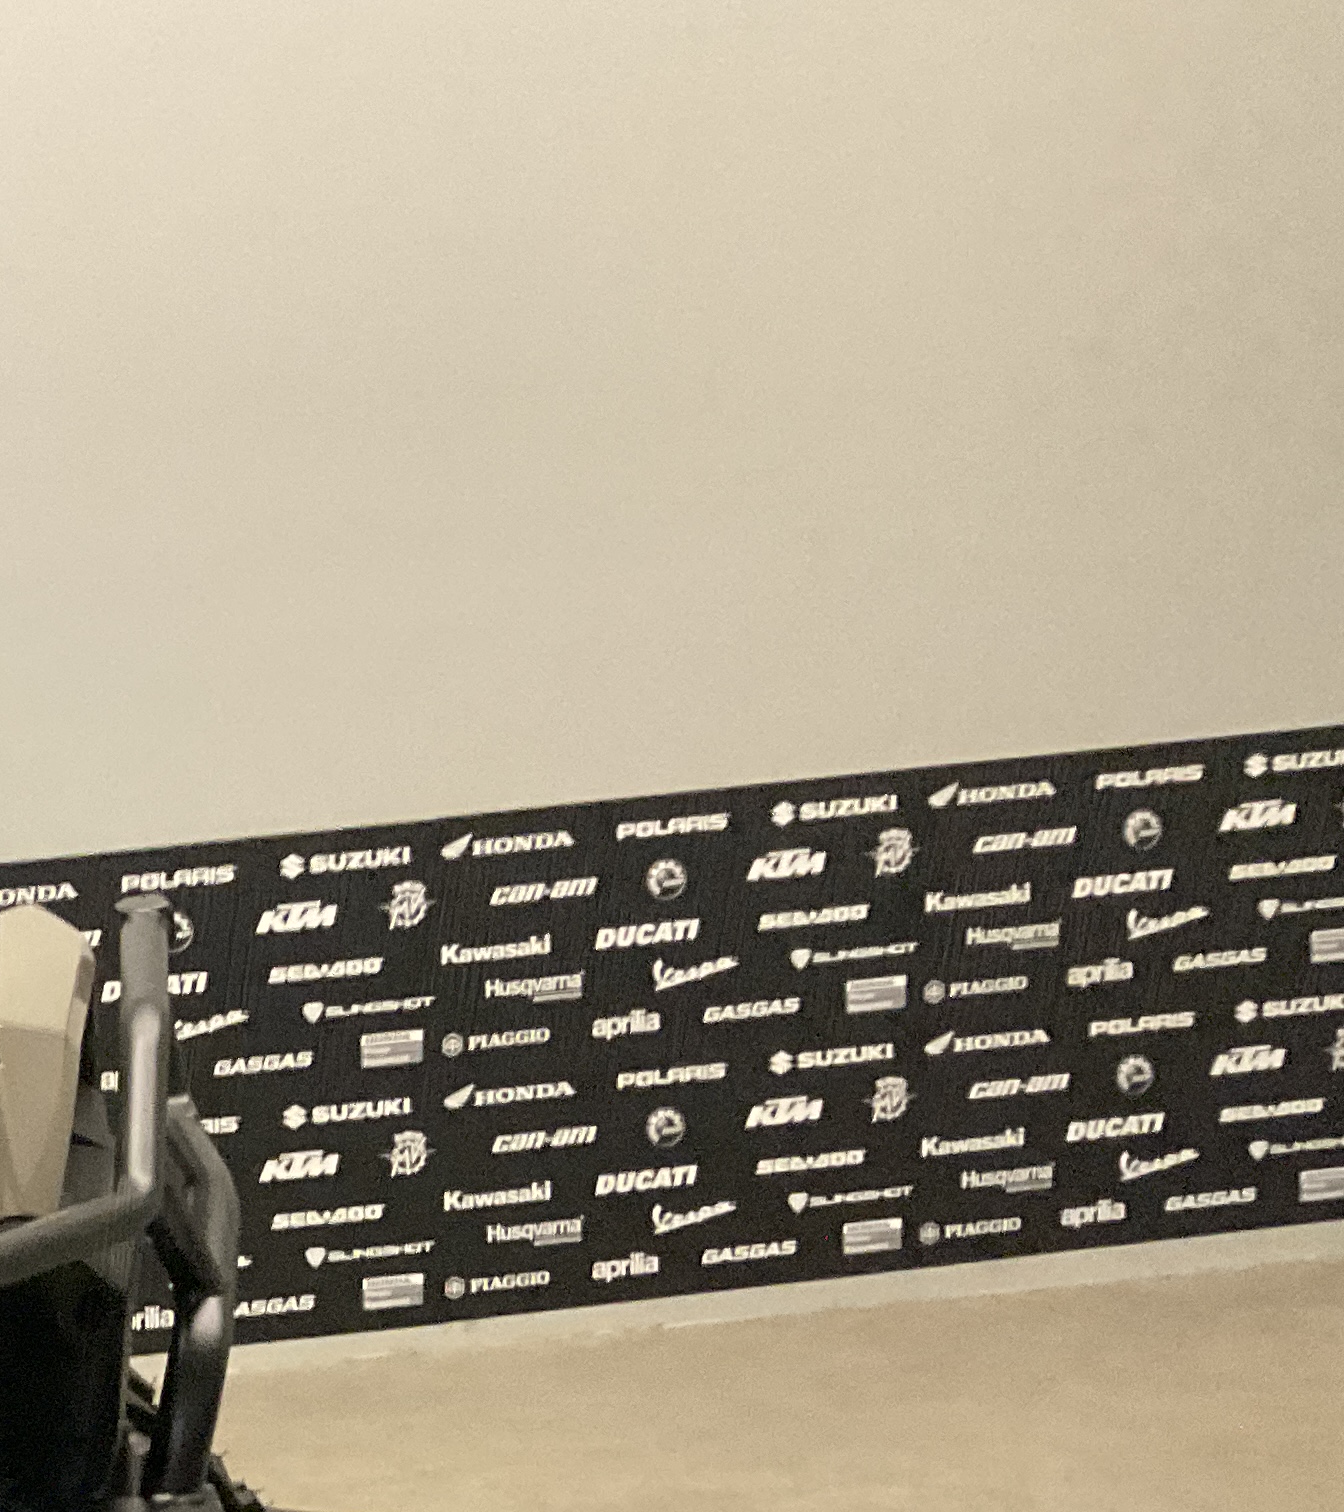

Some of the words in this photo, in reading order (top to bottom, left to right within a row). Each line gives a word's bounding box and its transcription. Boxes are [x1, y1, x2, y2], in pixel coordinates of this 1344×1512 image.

[1271, 748, 1344, 773] SUZU
[1094, 763, 1206, 791] POLARIS
[798, 793, 898, 822] SUZUKI
[956, 780, 1057, 806] HONDA
[615, 811, 731, 842] POLARIS
[1218, 798, 1298, 833] KTM
[471, 830, 575, 856] HONDA
[309, 845, 412, 875] SUZUKI
[745, 846, 827, 882] KTM
[120, 863, 238, 894] POLARIS
[1070, 867, 1175, 899] DUCATI
[924, 881, 1032, 914] Kawasaki
[255, 899, 339, 935] KTM
[440, 932, 552, 966] Kawasaki
[594, 917, 701, 951] DUCATI
[100, 970, 208, 1003] DATI
[484, 972, 582, 1003] Husqvarna
[651, 955, 740, 993] Vespa
[948, 975, 1029, 998] PIAGGIO
[591, 1008, 661, 1042] aprilia
[702, 996, 801, 1024] GASGAS
[1088, 1011, 1196, 1038] POLARIS
[466, 1027, 551, 1052] PIAGGIO
[952, 1028, 1051, 1053] HONDA
[212, 1050, 314, 1077] GASGAS
[795, 1042, 895, 1070] SUZUKI
[1209, 1044, 1287, 1077] KTM
[616, 1061, 729, 1091] POLARIS
[473, 1080, 577, 1106] HONDA
[310, 1096, 413, 1125] SUZUKI
[744, 1094, 824, 1130] KTM
[1065, 1111, 1166, 1143] DUCATI
[920, 1126, 1026, 1159] Kawasaki
[258, 1149, 340, 1184] KTM
[594, 1163, 699, 1197] DUCATI
[443, 1179, 552, 1212] Kawasaki
[1163, 1186, 1257, 1212] GASGAS
[486, 1217, 582, 1247] Husqvarna
[943, 1216, 1022, 1239] PIAGGIO
[591, 1251, 660, 1284] aprilia
[701, 1239, 798, 1266] GASGAS
[470, 1270, 551, 1294] PIAGGIO
[131, 1305, 175, 1332] rilia
[232, 1293, 316, 1319] ASGAS
